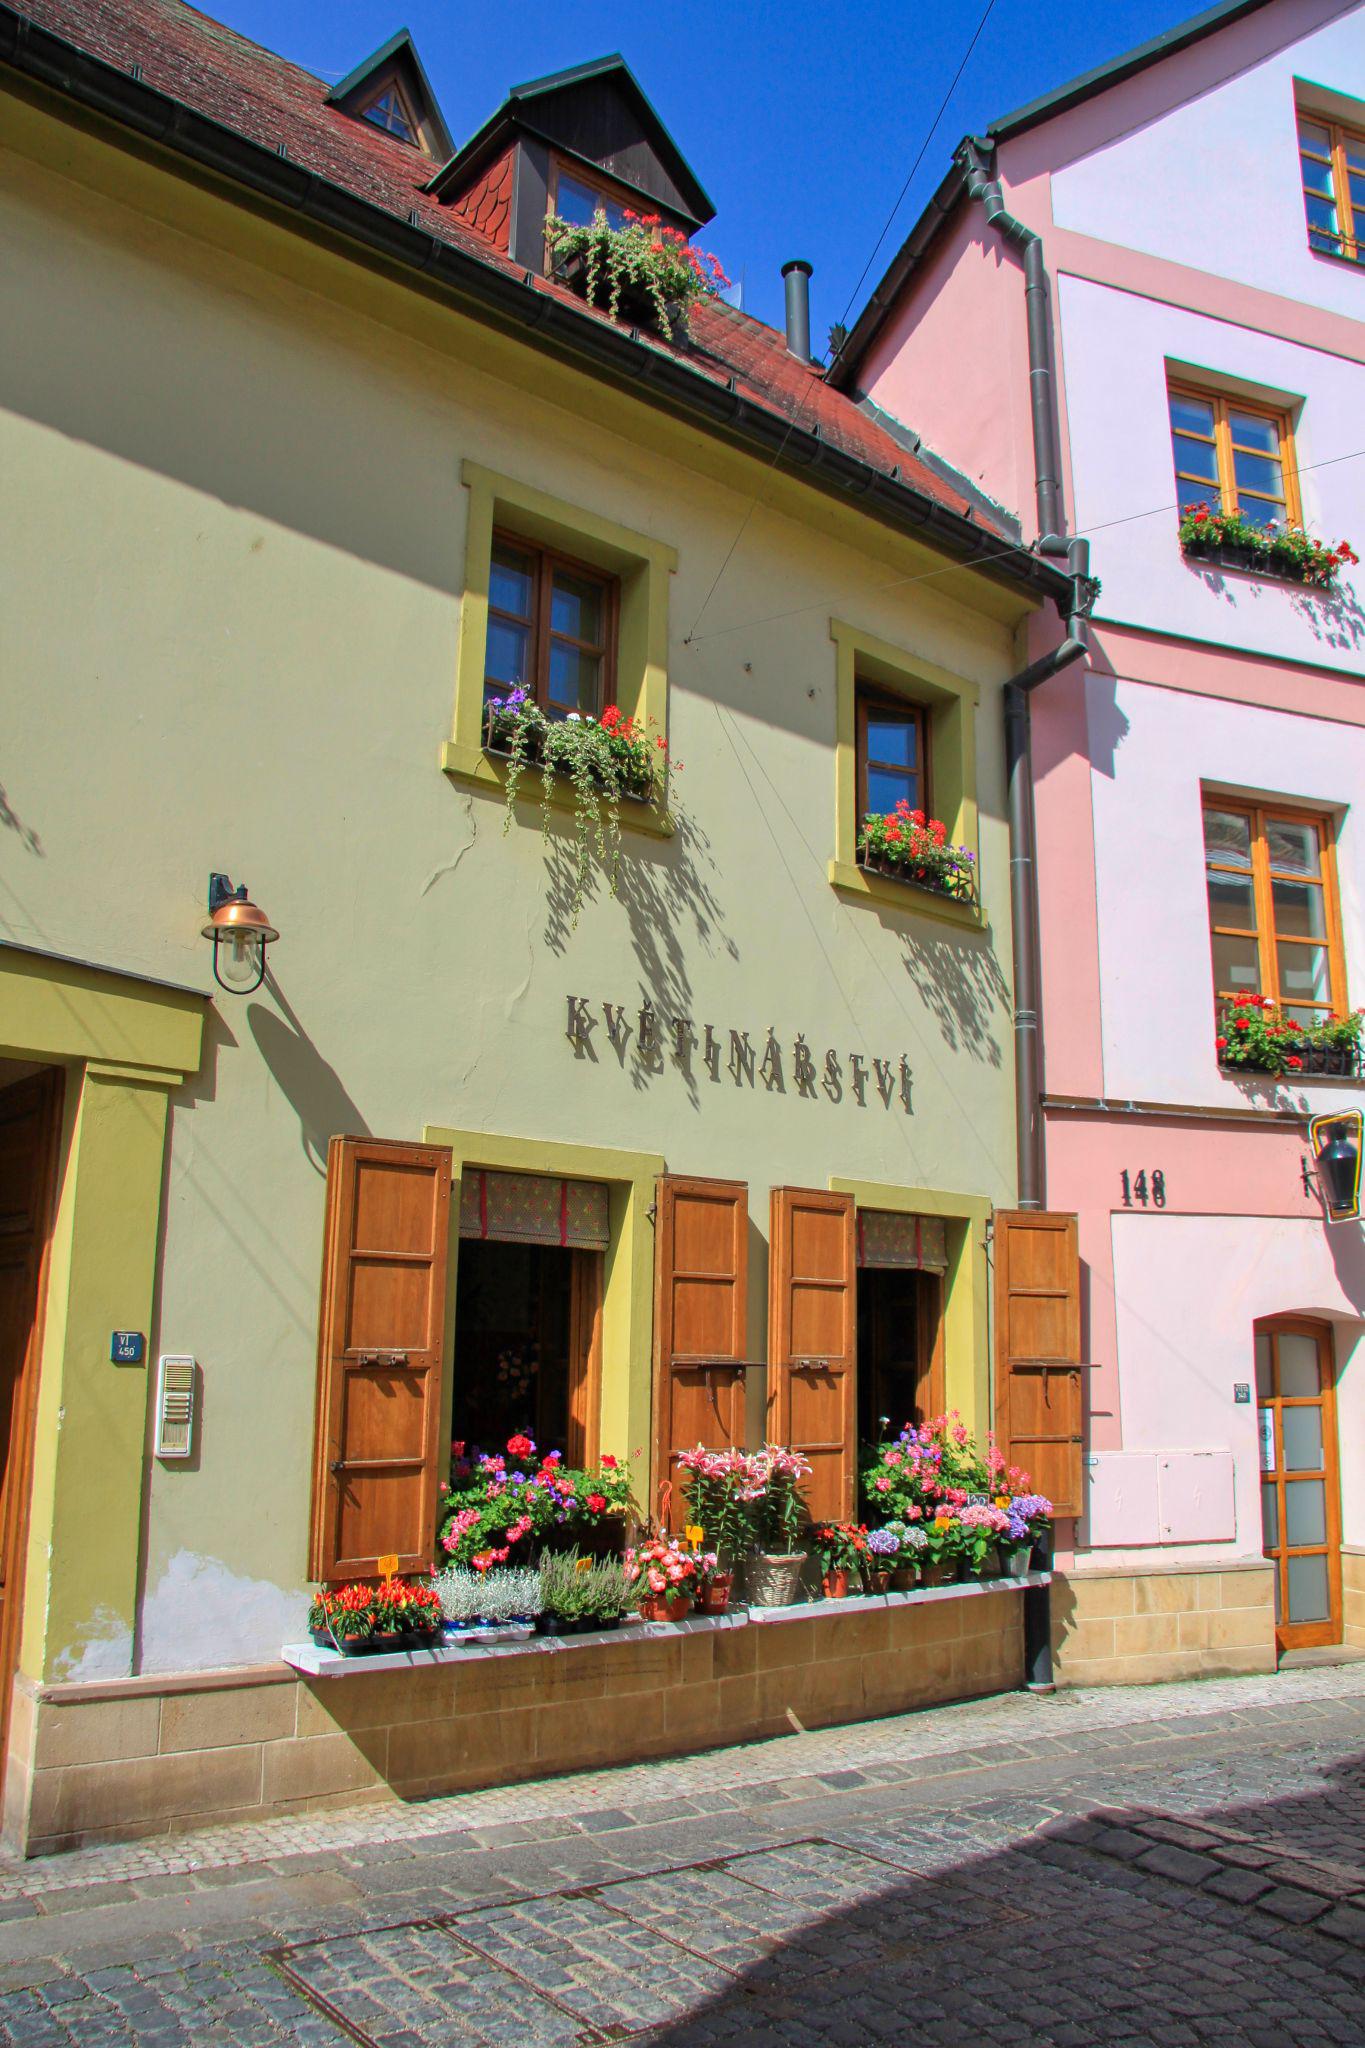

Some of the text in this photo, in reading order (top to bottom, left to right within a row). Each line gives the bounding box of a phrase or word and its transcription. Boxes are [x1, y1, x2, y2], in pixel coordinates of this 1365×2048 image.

[566, 995, 911, 1101] KVĚTINÁŘSTVÍ
[1120, 1168, 1165, 1205] 148
[119, 1347, 135, 1356] 450
